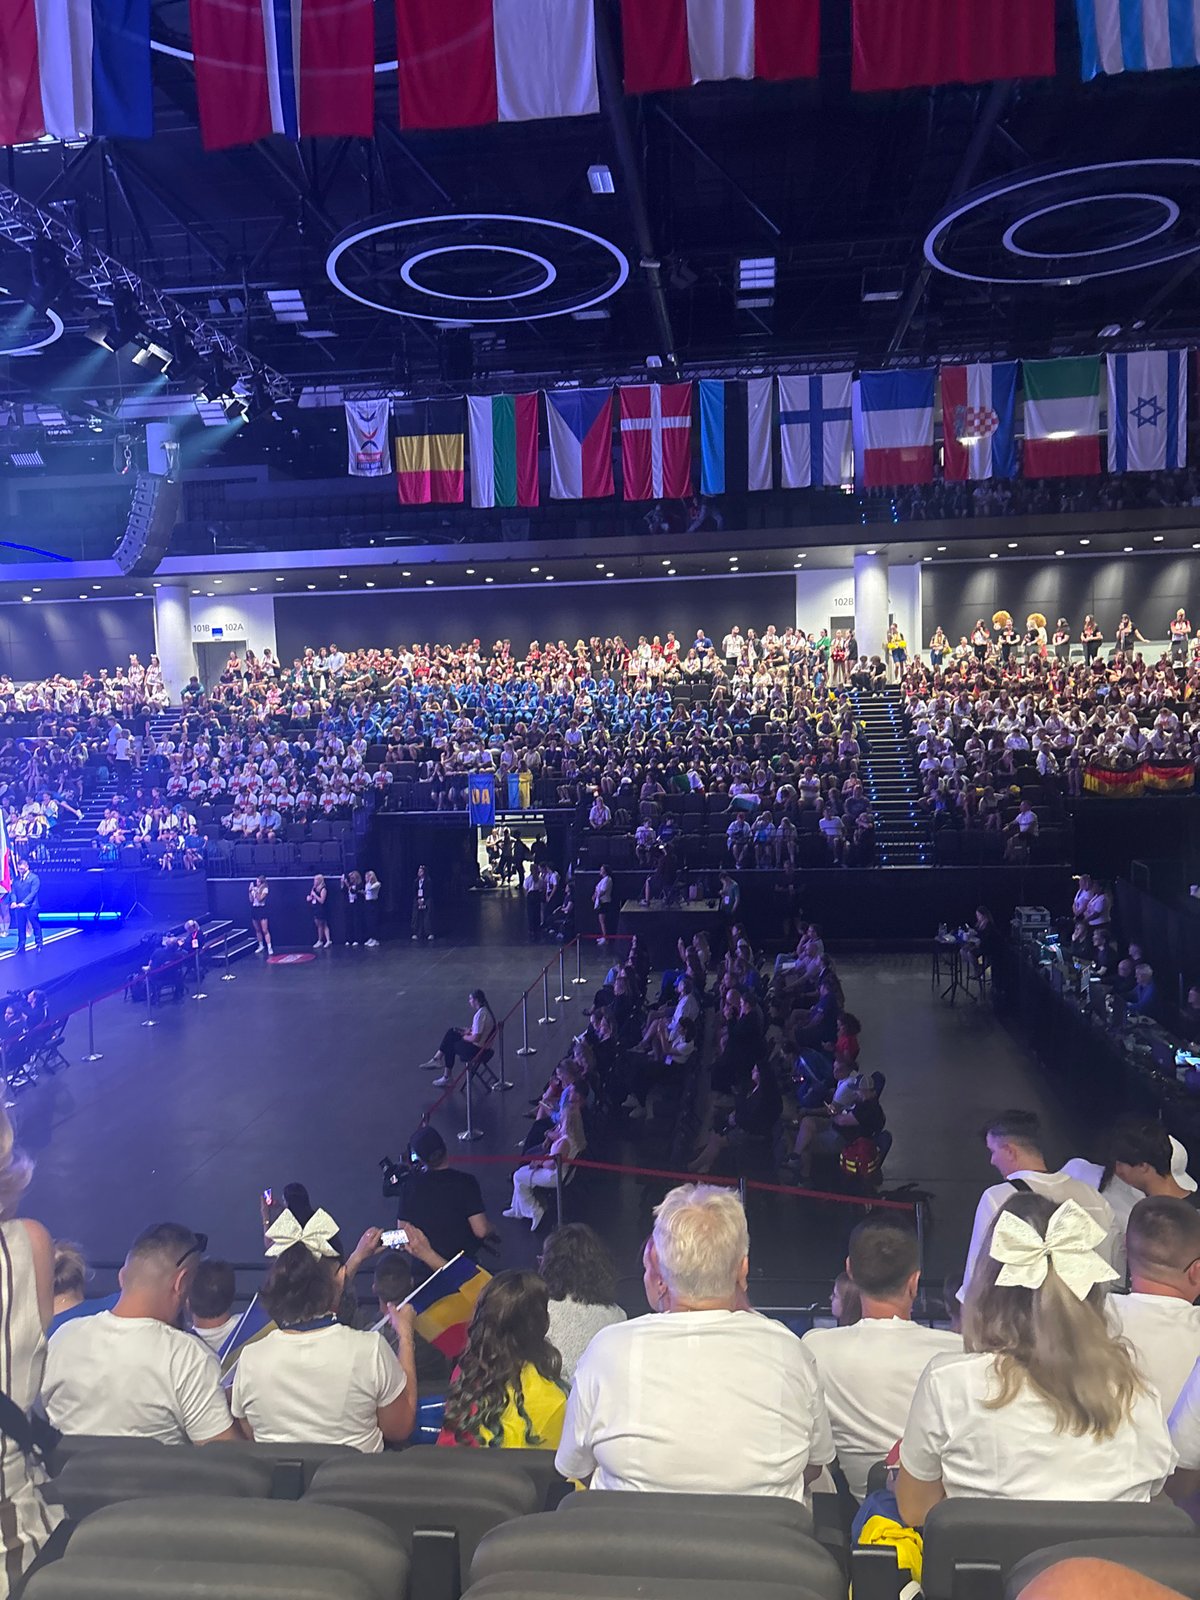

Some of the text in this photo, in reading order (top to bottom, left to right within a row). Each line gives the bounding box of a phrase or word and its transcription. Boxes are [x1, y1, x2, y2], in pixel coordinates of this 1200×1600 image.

[834, 598, 854, 606] 102B
[193, 623, 244, 632] 101B 102A
